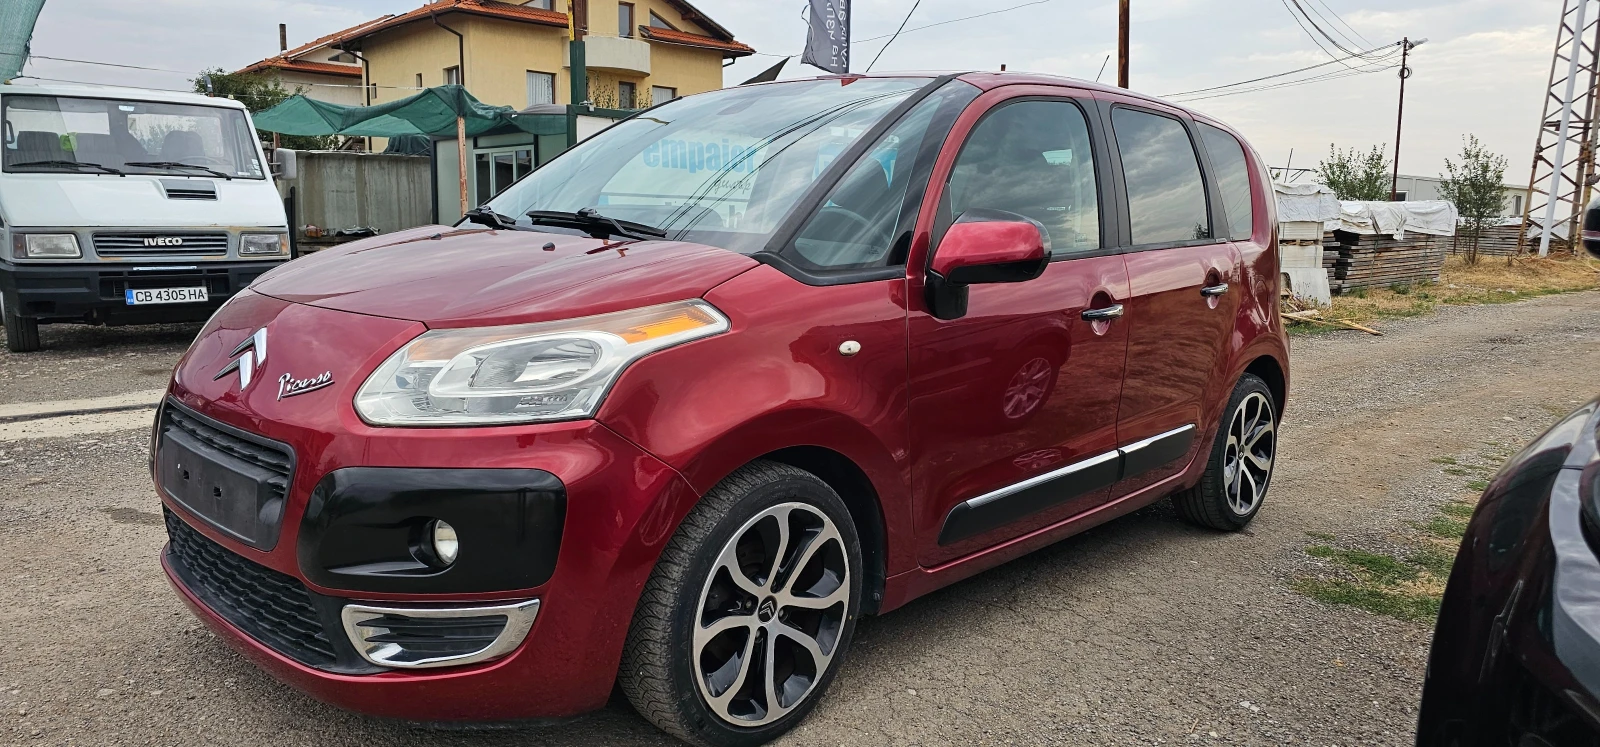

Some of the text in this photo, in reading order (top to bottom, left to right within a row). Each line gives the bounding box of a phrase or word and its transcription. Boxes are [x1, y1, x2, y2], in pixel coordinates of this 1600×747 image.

[144, 237, 183, 246] IVECO
[135, 289, 205, 302] CB 4305 HA
[276, 370, 335, 401] Picasso
